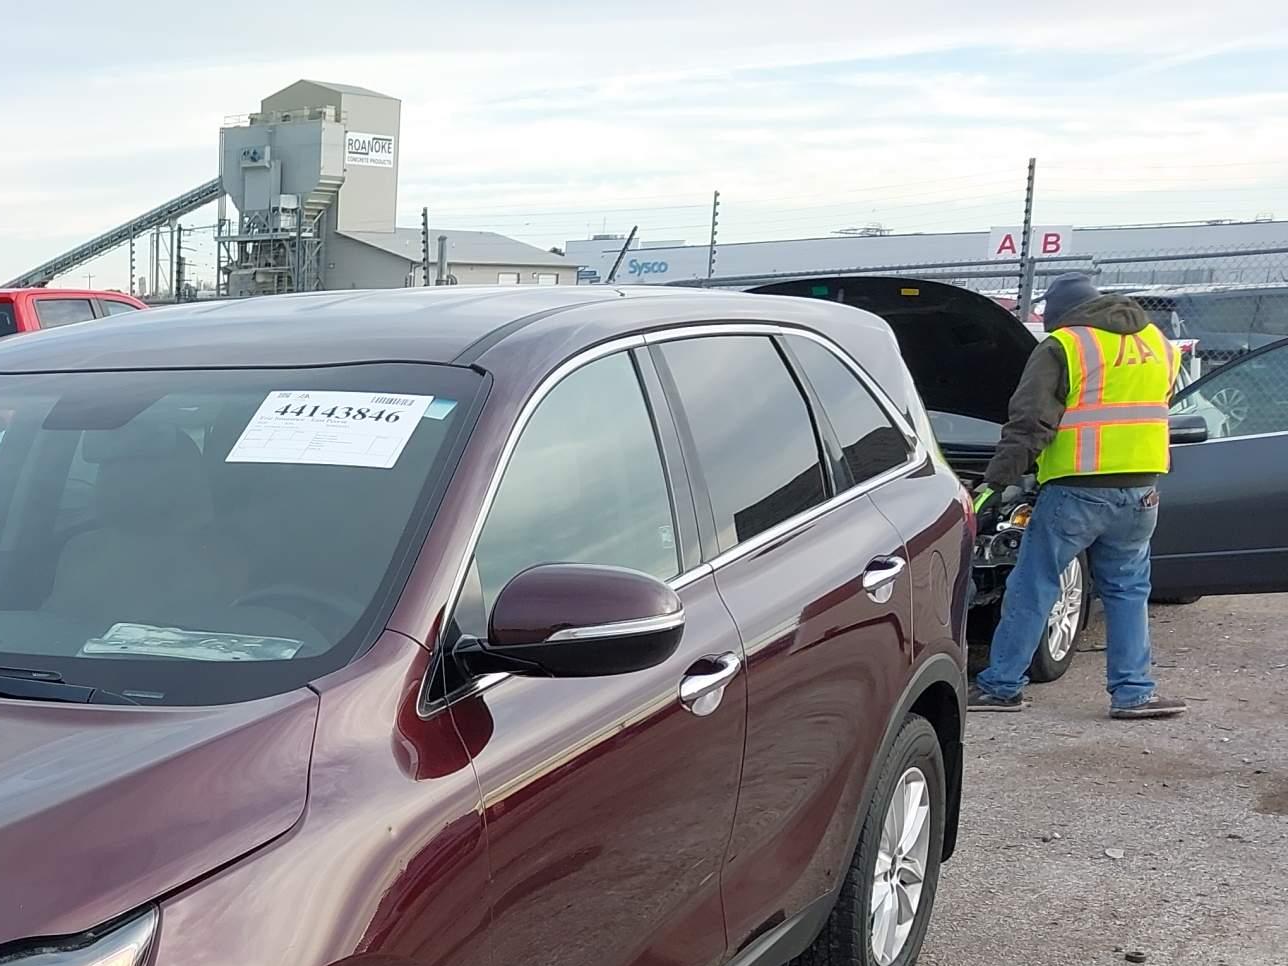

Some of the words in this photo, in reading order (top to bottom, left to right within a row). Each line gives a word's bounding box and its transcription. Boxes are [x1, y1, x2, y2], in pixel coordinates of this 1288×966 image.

[348, 138, 393, 155] ROANOKE
[997, 234, 1016, 254] A
[1042, 233, 1061, 254] B
[629, 259, 669, 276] Sysco
[274, 403, 408, 424] 44143846
